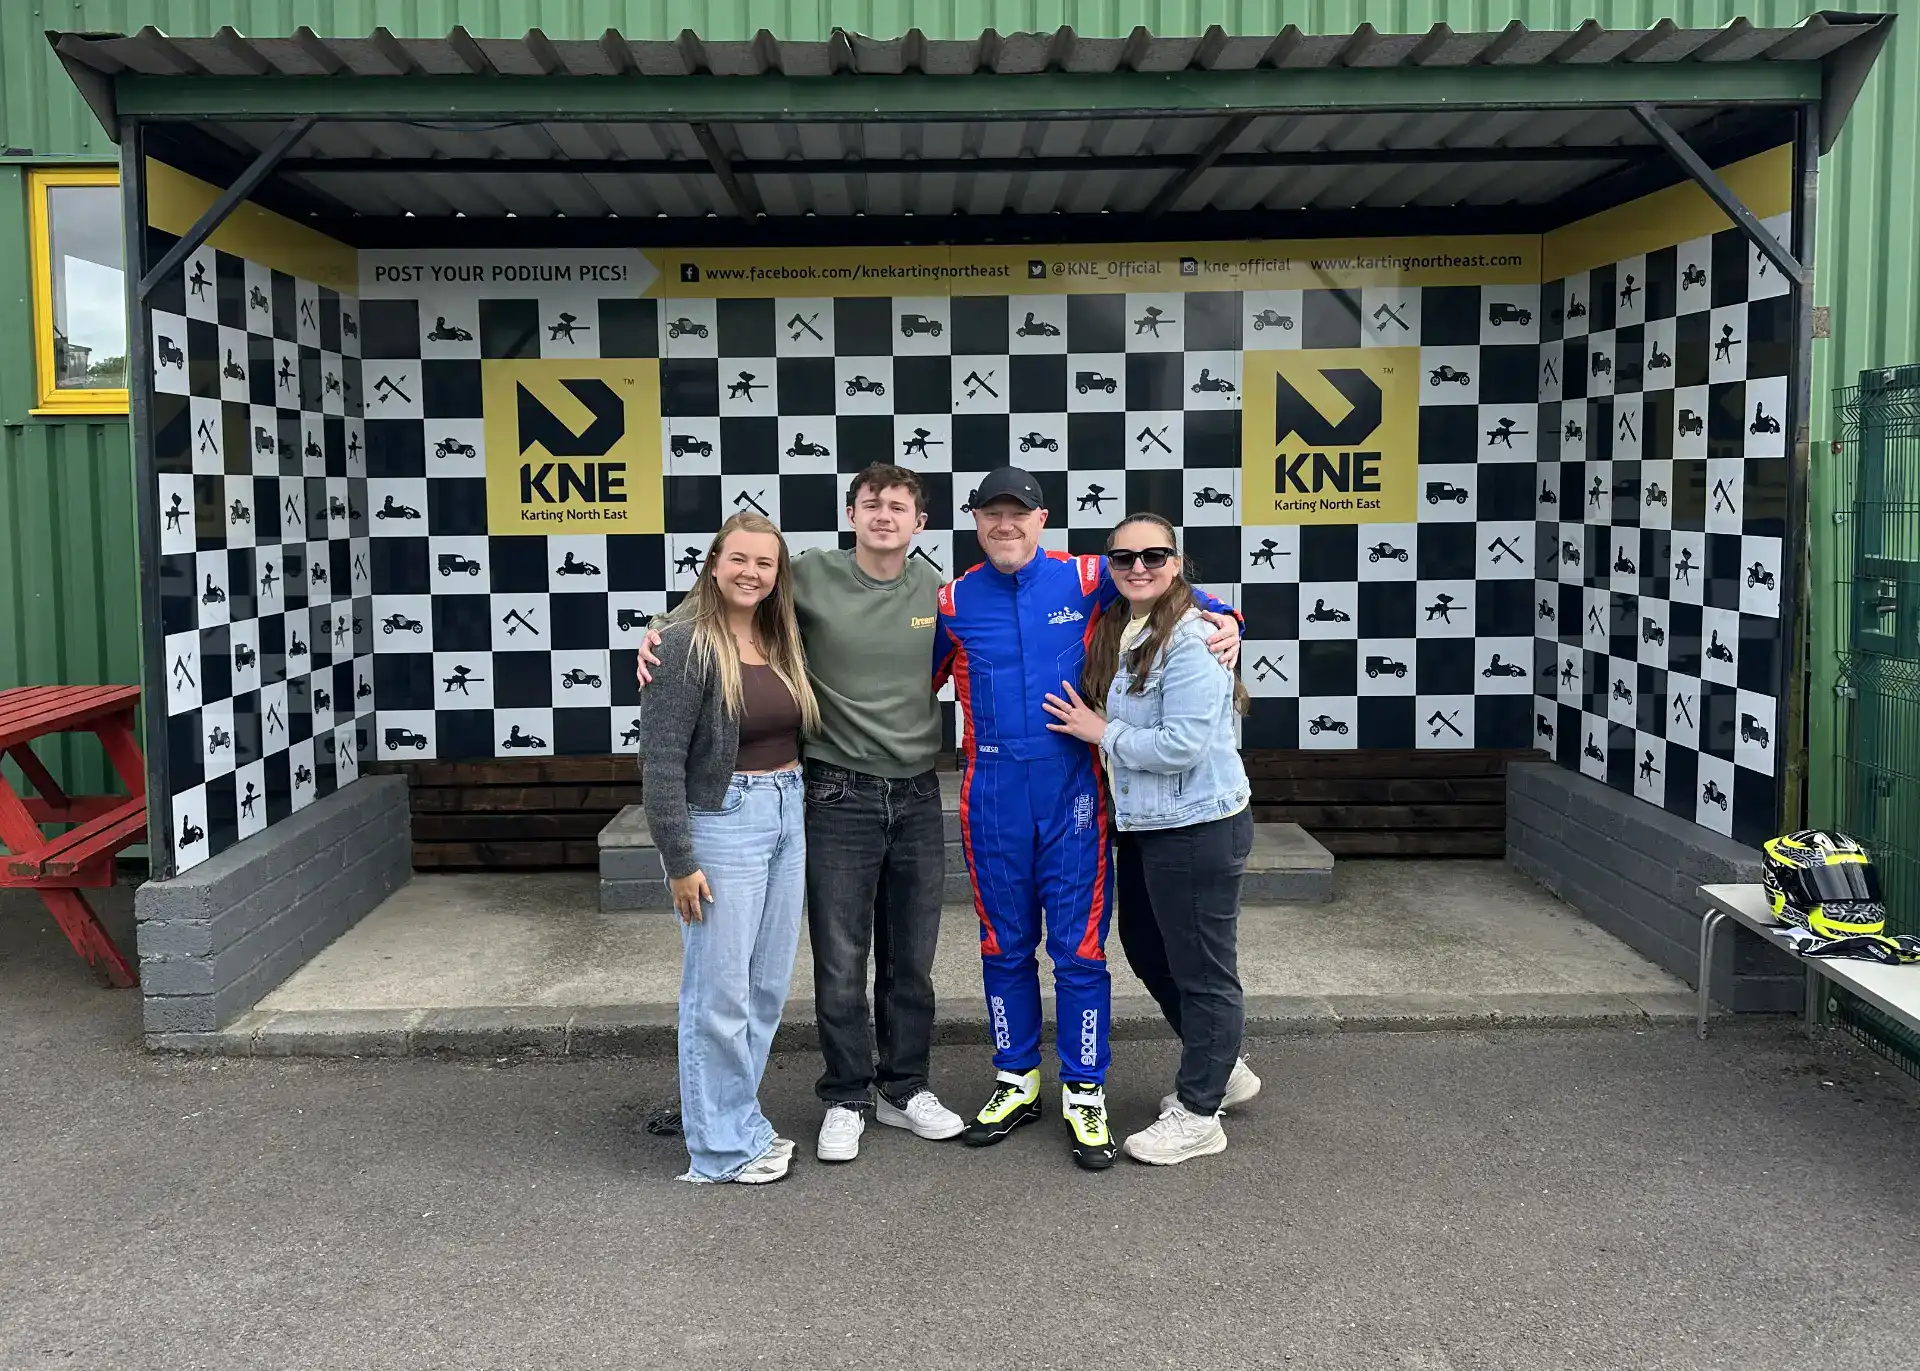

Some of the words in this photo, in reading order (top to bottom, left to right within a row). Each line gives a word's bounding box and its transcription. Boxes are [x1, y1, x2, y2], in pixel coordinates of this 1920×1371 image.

[1051, 260, 1161, 279] @KNE_Official
[1204, 258, 1291, 277] kne_official
[1310, 253, 1522, 271] www.kartingnortheast.com
[375, 266, 424, 282] POST
[431, 265, 485, 282] YOUR
[492, 265, 572, 282] PODIUM
[579, 265, 628, 281] PICS!
[705, 264, 1011, 282] www.facebook.com/knekartingnortheast
[1275, 452, 1382, 494] KNE
[520, 462, 628, 504] KNE
[1275, 500, 1317, 512] Karting
[1320, 499, 1353, 510] North
[1356, 498, 1381, 509] East
[521, 510, 563, 522] Karting
[567, 509, 600, 520] North
[603, 509, 628, 519] East
[991, 995, 1011, 1050] sparco
[1081, 1009, 1097, 1066] sparco
